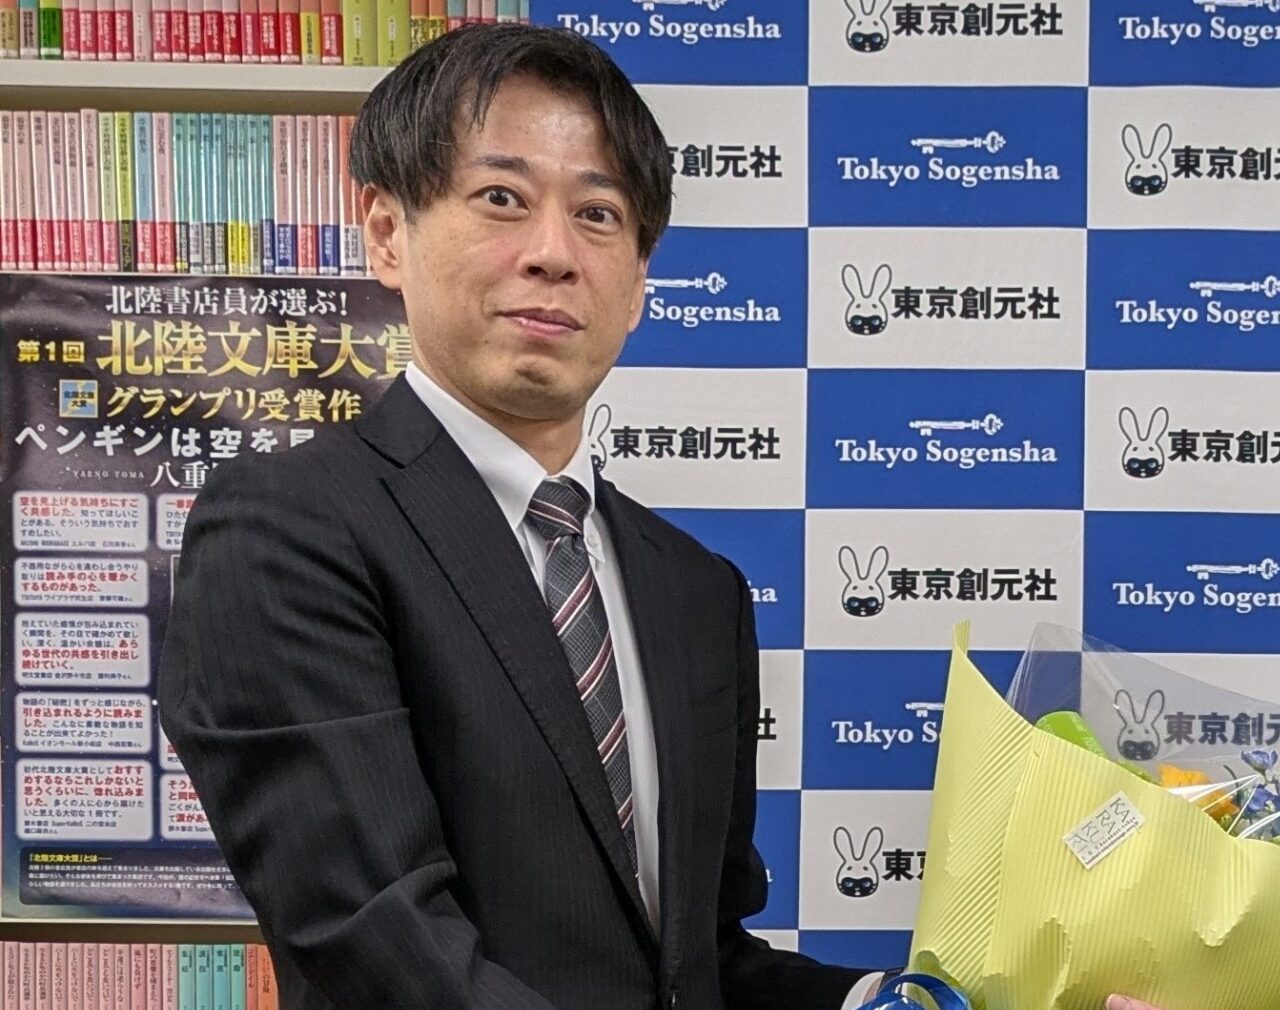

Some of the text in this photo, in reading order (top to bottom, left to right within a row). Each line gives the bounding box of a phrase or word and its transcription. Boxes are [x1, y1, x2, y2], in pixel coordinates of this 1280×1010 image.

[559, 14, 781, 44] Tokyo Sogensha
[893, 3, 1063, 36] 東京創元社
[1119, 17, 1201, 45] Tokyo
[668, 144, 782, 179] 創元社
[838, 158, 1060, 187] Tokyo Sogensha
[650, 298, 780, 327] Sogensha
[892, 286, 1060, 319] 東京創元社
[1116, 300, 1198, 329] Tokyo
[17, 341, 86, 363] 第1回
[107, 387, 362, 422] グランプリ受賞作
[15, 425, 315, 459] ペンギンは空を
[610, 426, 780, 459] 東京創元社
[835, 440, 1057, 469] Tokyo Sogensha
[114, 470, 145, 479] TOMA
[888, 568, 1057, 601] 東京創元社
[1113, 583, 1195, 612] Tokyo
[832, 721, 913, 749] Tokyo
